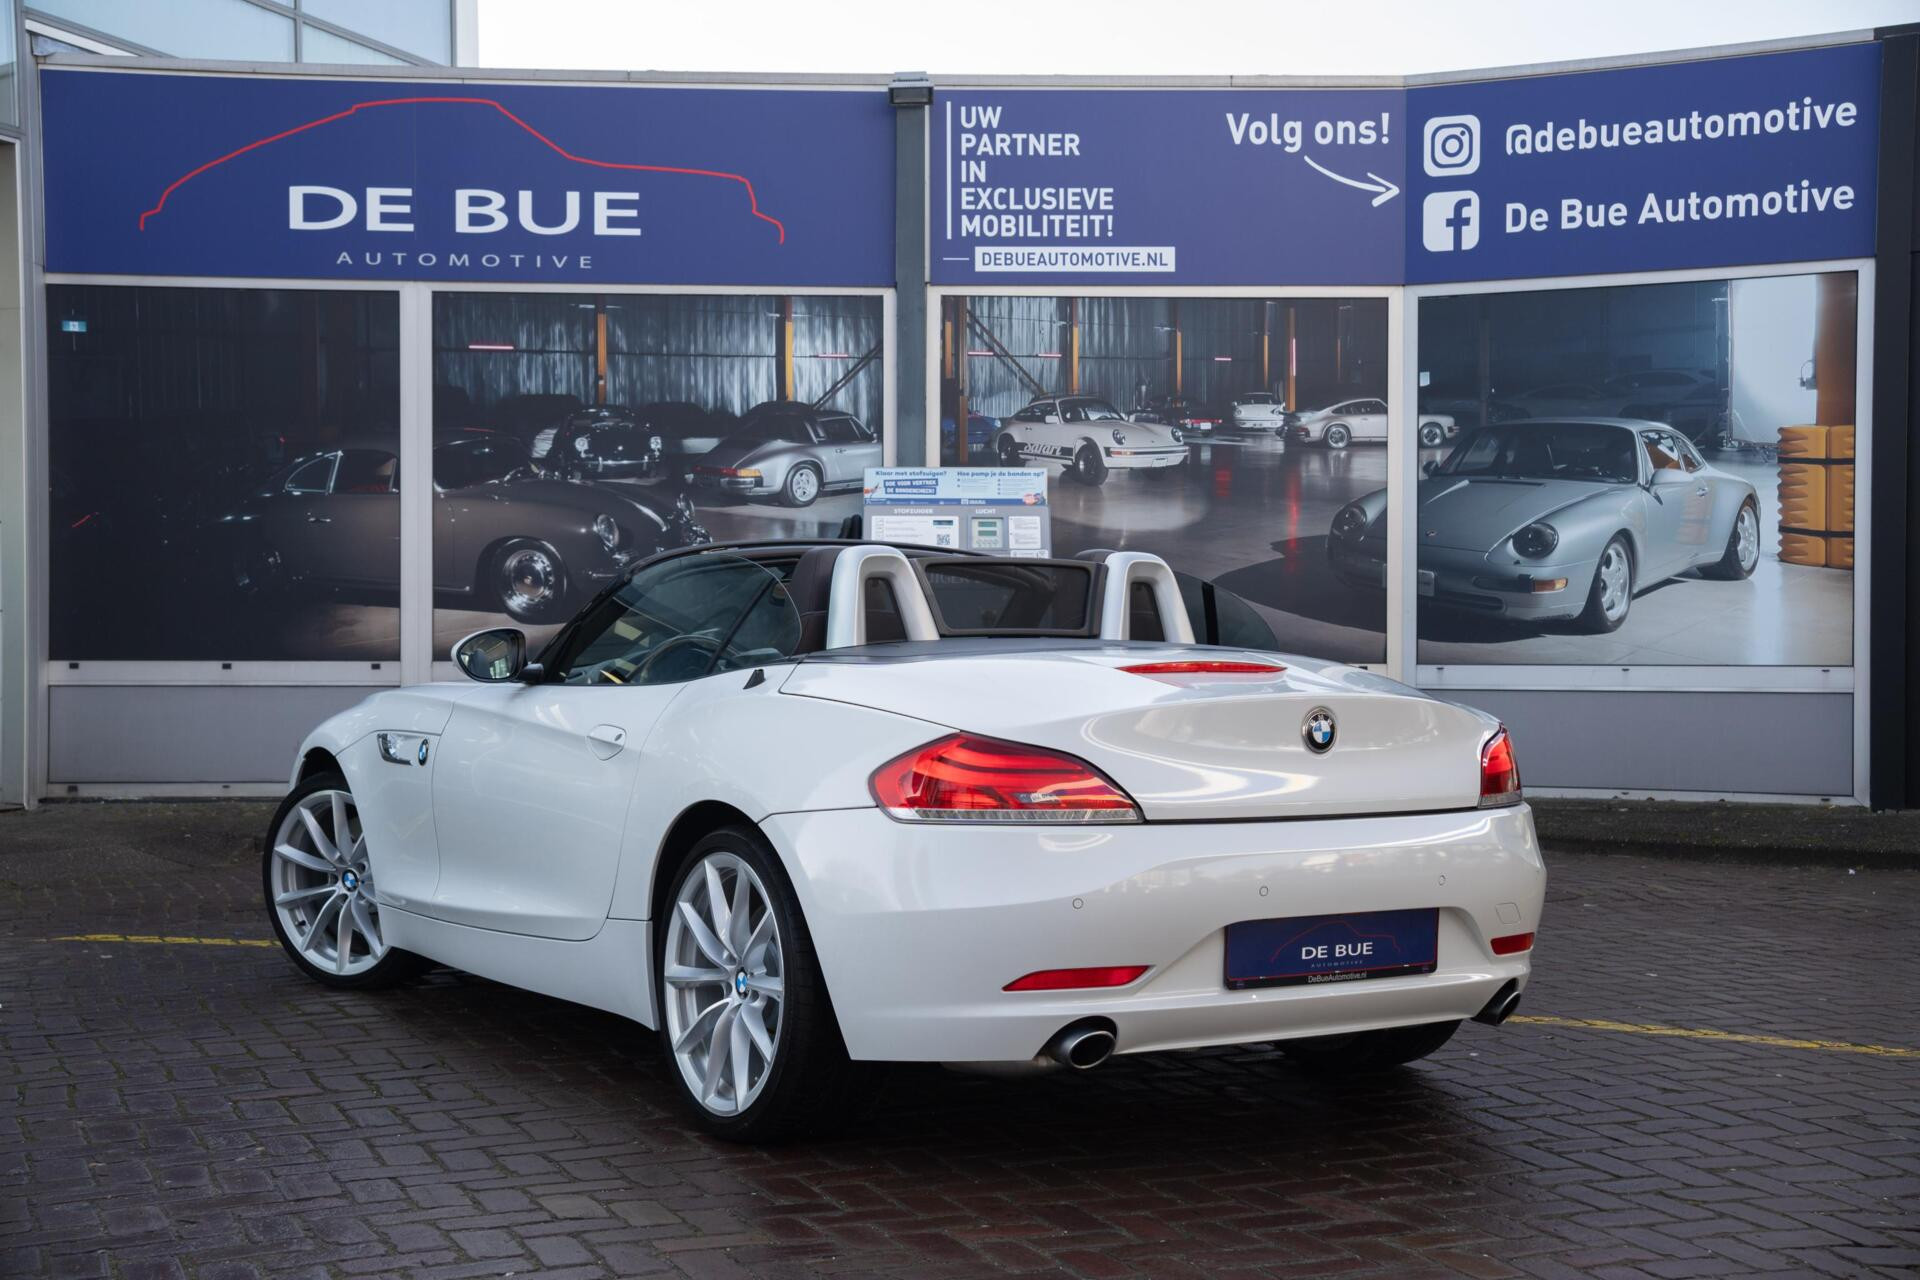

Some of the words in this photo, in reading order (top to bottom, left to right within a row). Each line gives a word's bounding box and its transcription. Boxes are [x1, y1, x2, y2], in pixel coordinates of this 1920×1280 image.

[960, 106, 1002, 129] UW
[1505, 97, 1858, 156] @debueautomotive
[960, 133, 1081, 156] PARTNER
[1226, 113, 1302, 153] Volg
[1315, 113, 1390, 145] ons!
[961, 161, 987, 183] IN
[289, 185, 414, 232] DE
[455, 188, 641, 236] BUE
[961, 188, 1114, 211] EXCLUSIEVE
[1505, 202, 1549, 234] De
[1561, 196, 1628, 230] Bue
[1638, 180, 1855, 225] Automotive
[961, 214, 1114, 237] MOBILITEIT!
[336, 252, 593, 269] AUTOMOTIVE
[981, 251, 1169, 267] DEBUEAUTOMOTIVE.NL
[1301, 945, 1328, 960] DE
[1335, 942, 1373, 957] BUE
[1308, 970, 1367, 984] DeBueAutomotive.nl
